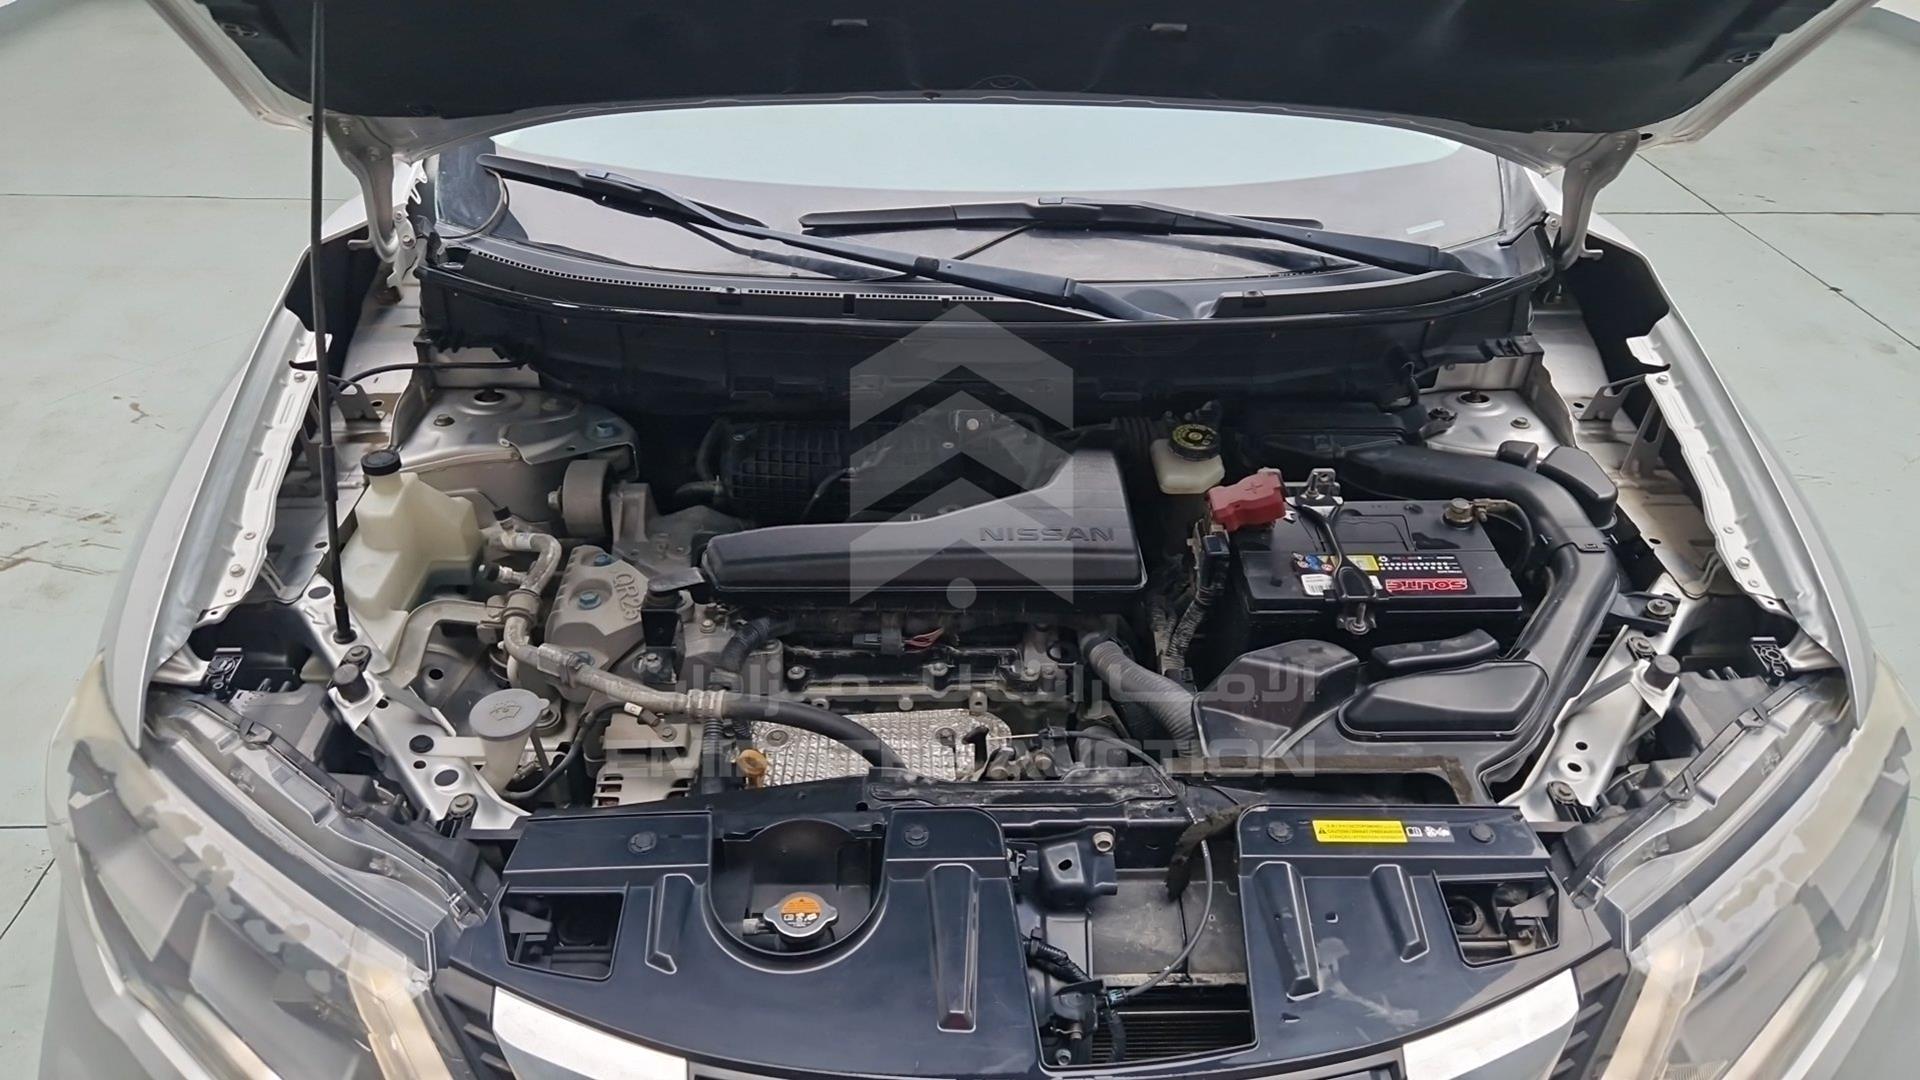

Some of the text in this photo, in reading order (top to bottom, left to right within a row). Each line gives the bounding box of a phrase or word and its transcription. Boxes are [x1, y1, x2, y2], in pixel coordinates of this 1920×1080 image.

[979, 527, 1115, 542] NISSAN
[1385, 578, 1468, 592] SOLITE
[613, 573, 641, 621] QR25
